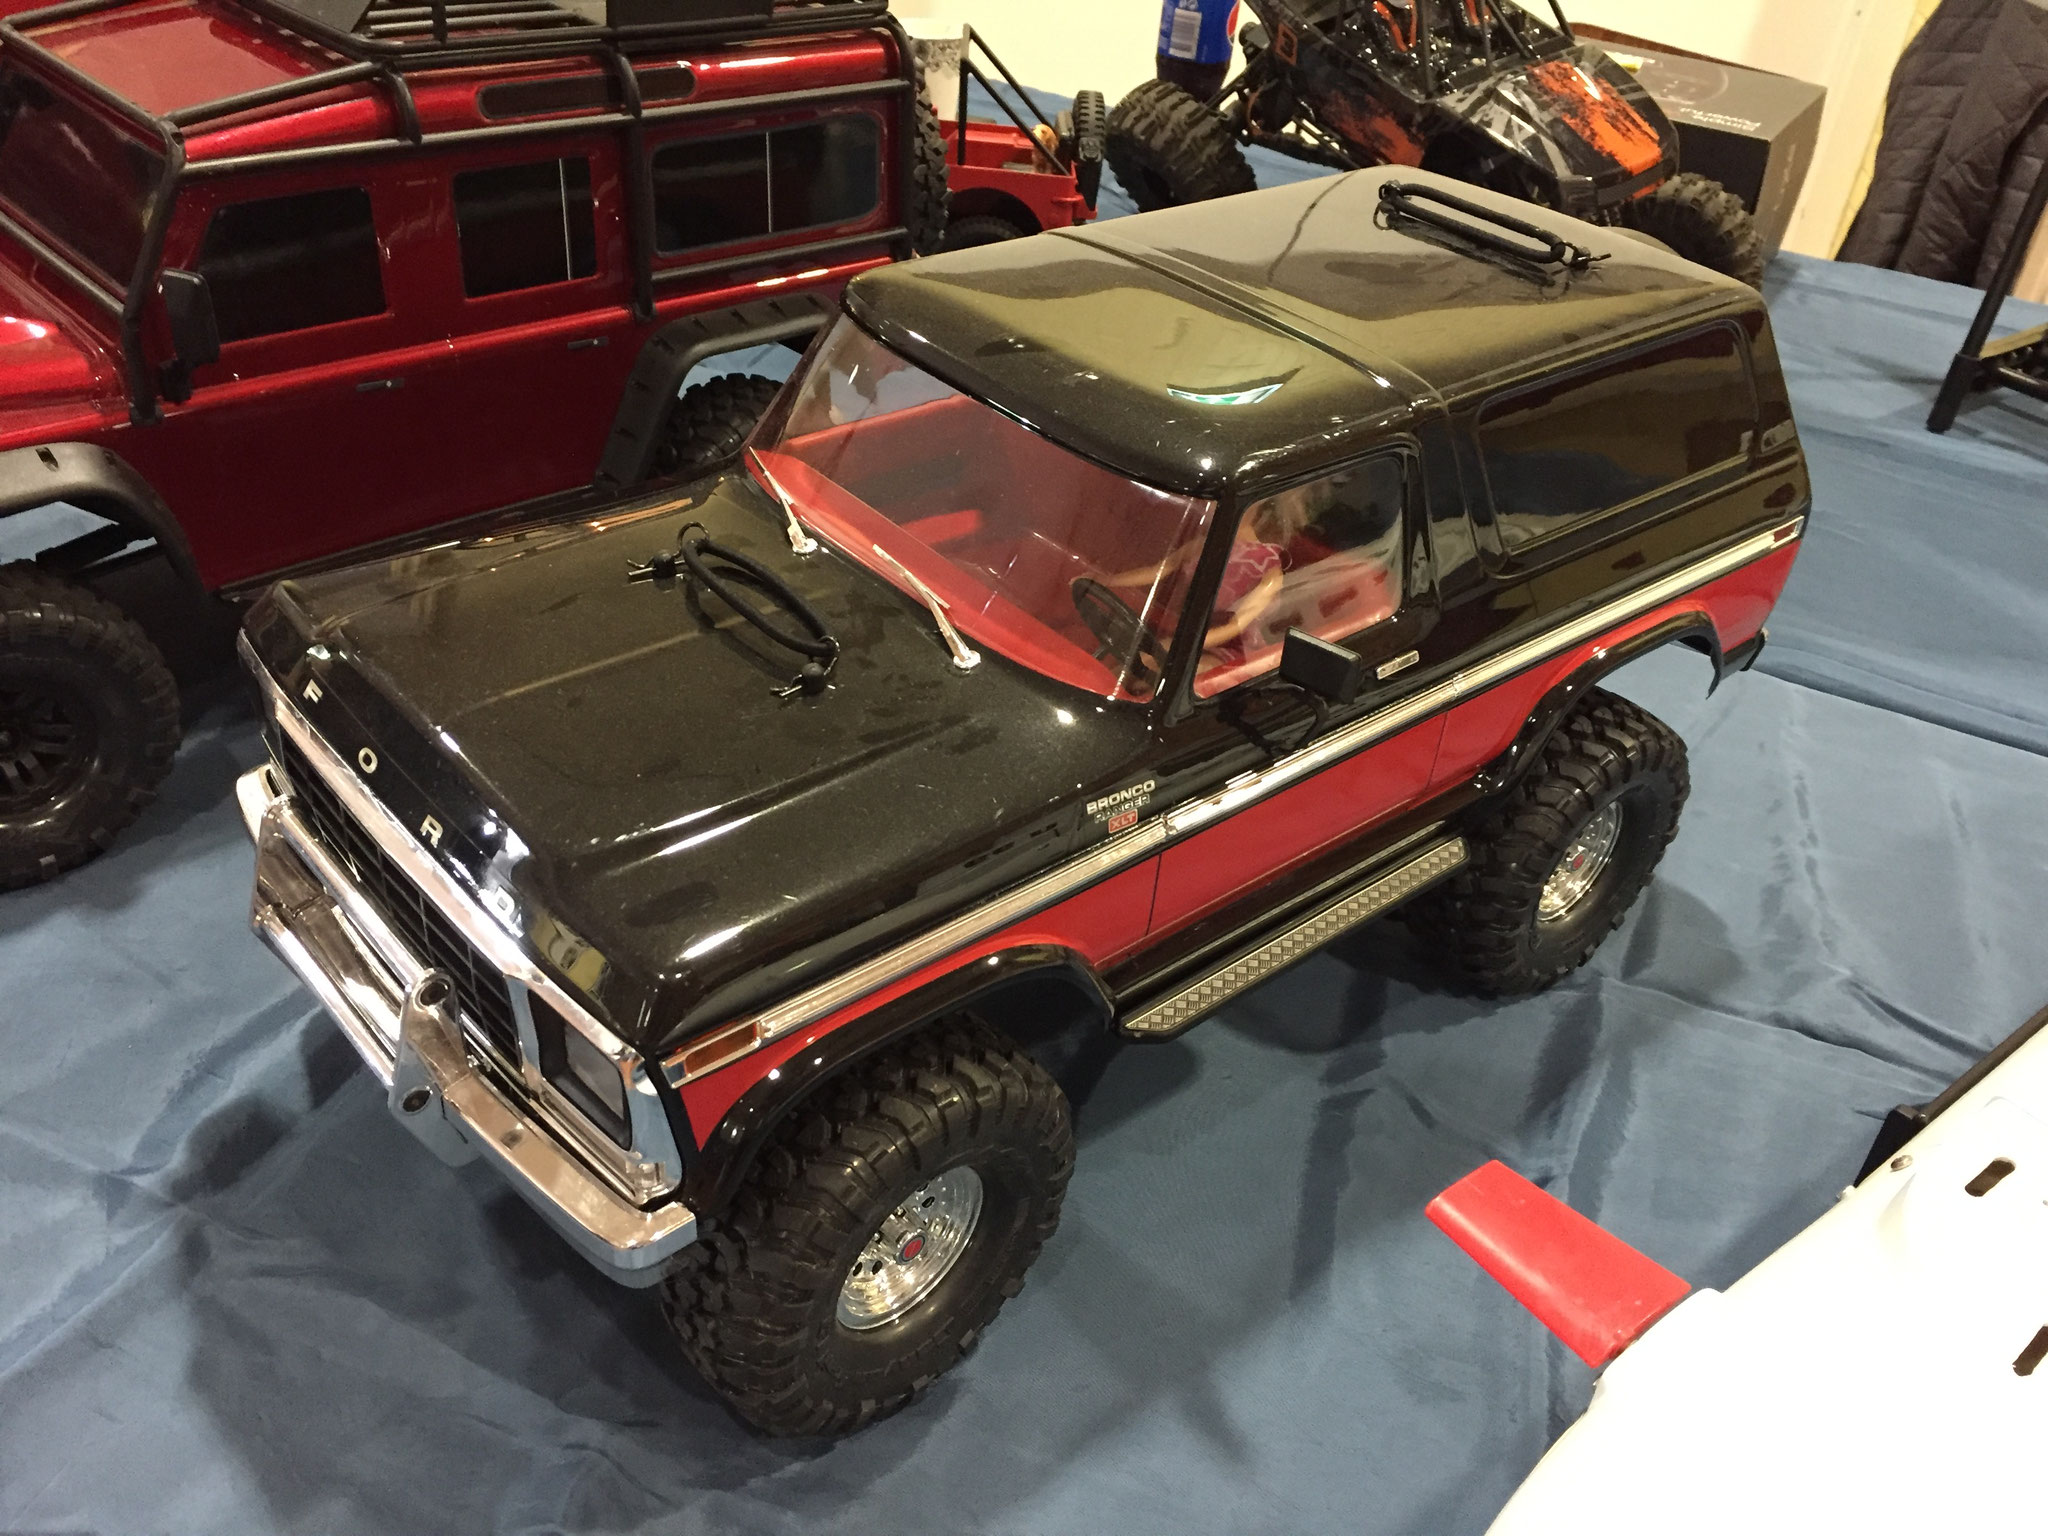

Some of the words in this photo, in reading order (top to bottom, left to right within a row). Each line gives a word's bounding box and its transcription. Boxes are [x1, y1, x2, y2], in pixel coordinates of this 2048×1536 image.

[303, 679, 516, 921] FORD
[1087, 780, 1155, 814] BRONCO
[1094, 794, 1150, 823] RANGER
[1110, 811, 1136, 831] XLT
